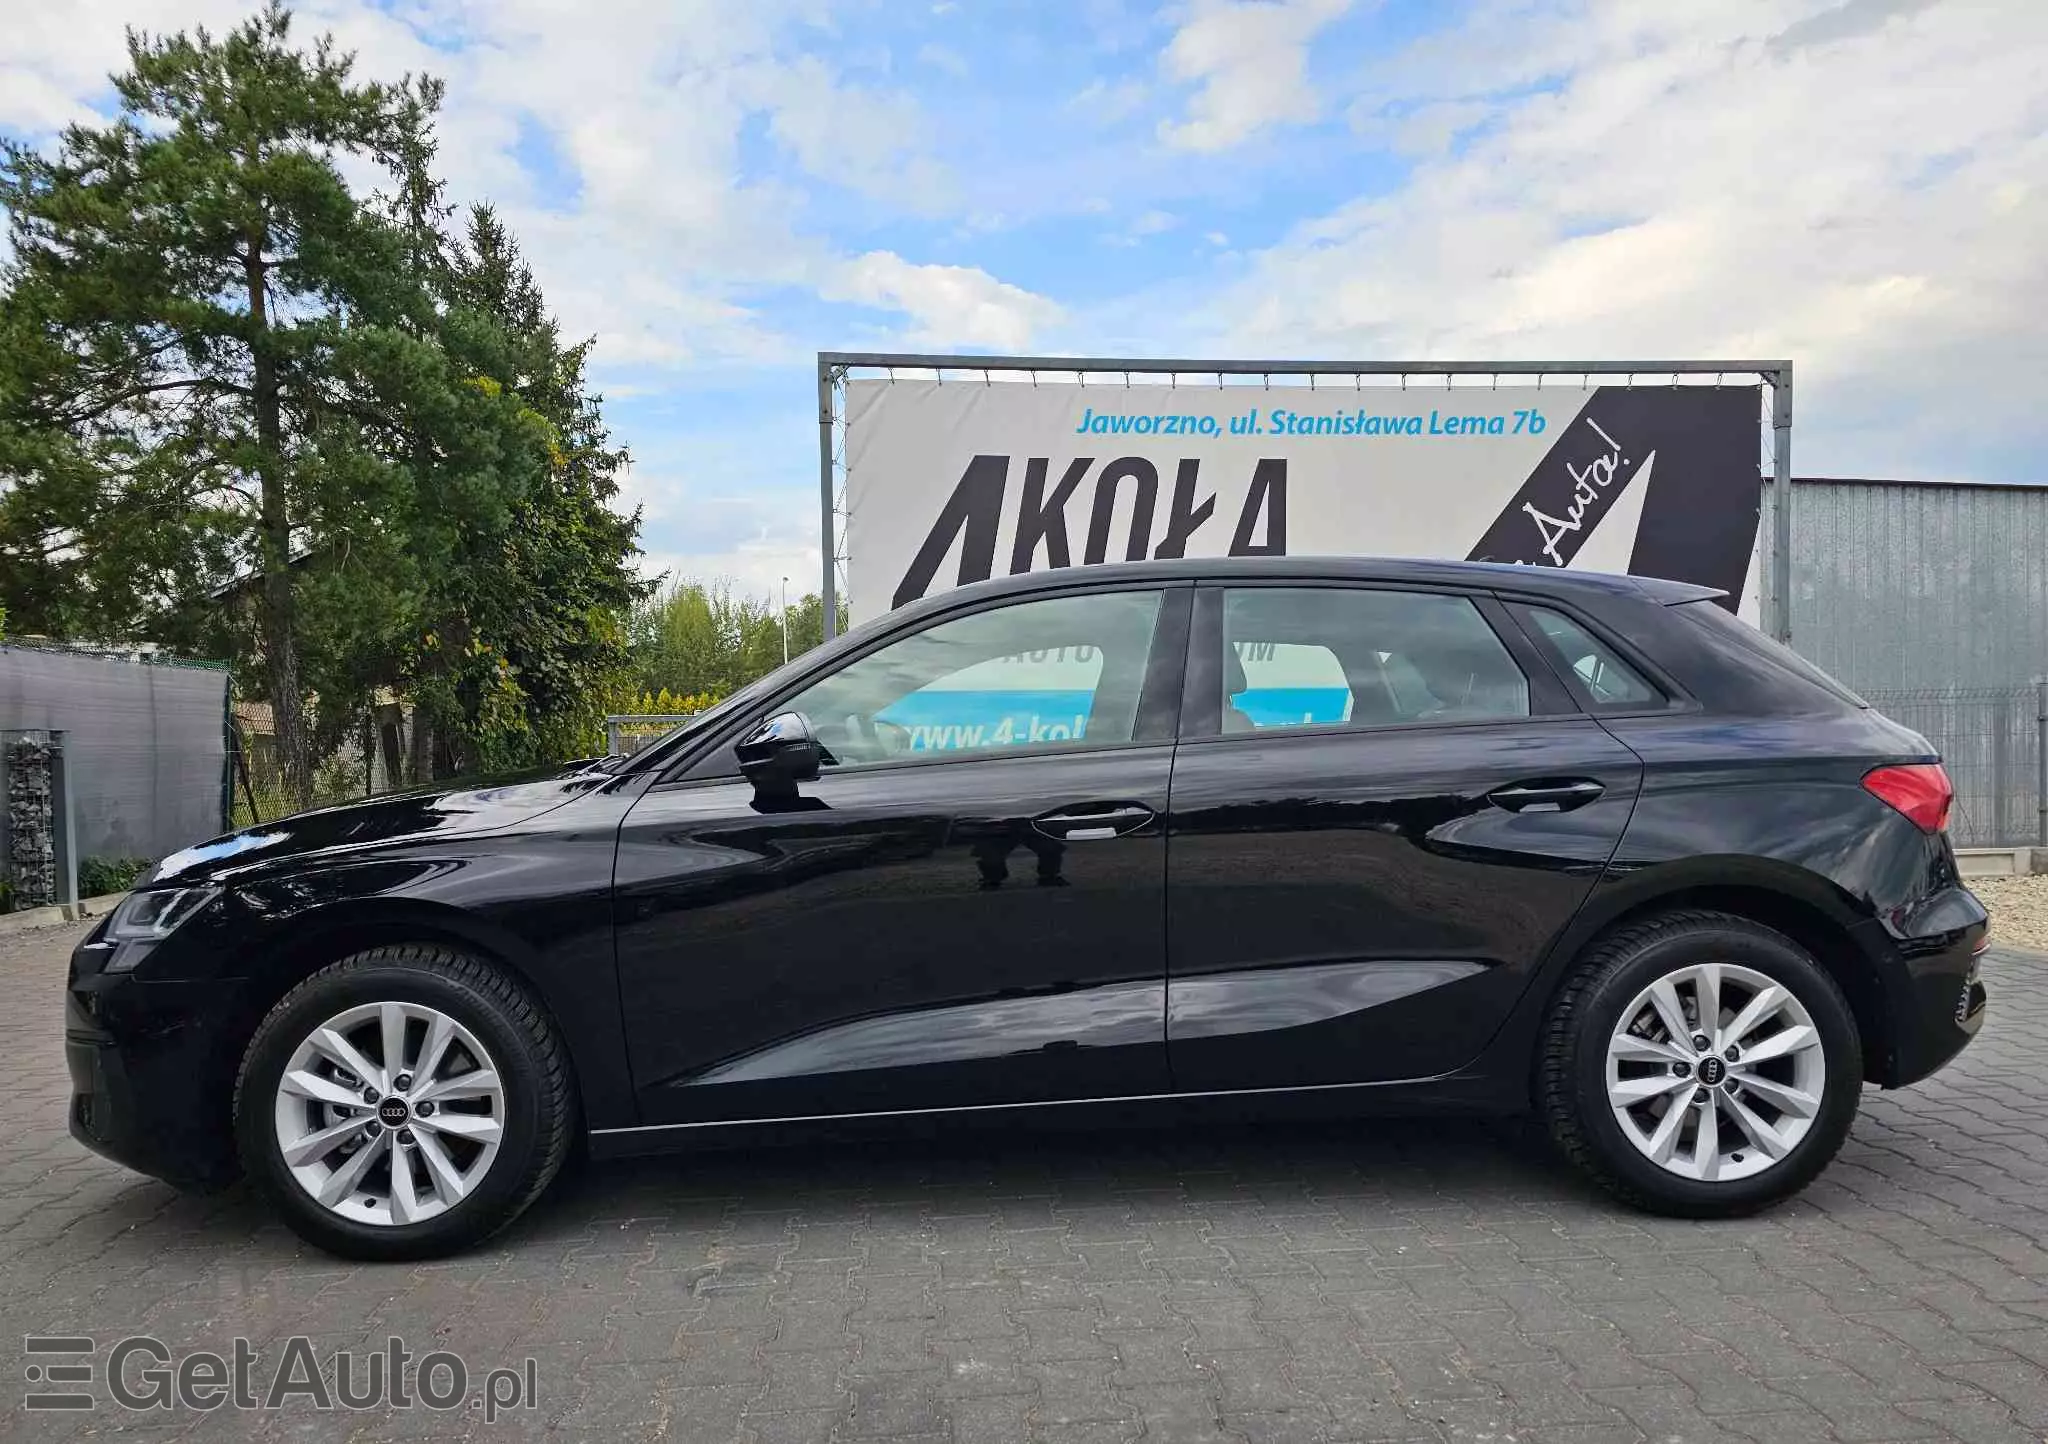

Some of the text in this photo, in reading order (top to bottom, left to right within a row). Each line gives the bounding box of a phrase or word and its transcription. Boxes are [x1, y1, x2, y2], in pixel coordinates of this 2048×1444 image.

[1075, 408, 1547, 439] Jaworzno, ul. Stanisława Lema 7b
[1522, 416, 1630, 567] Auta!
